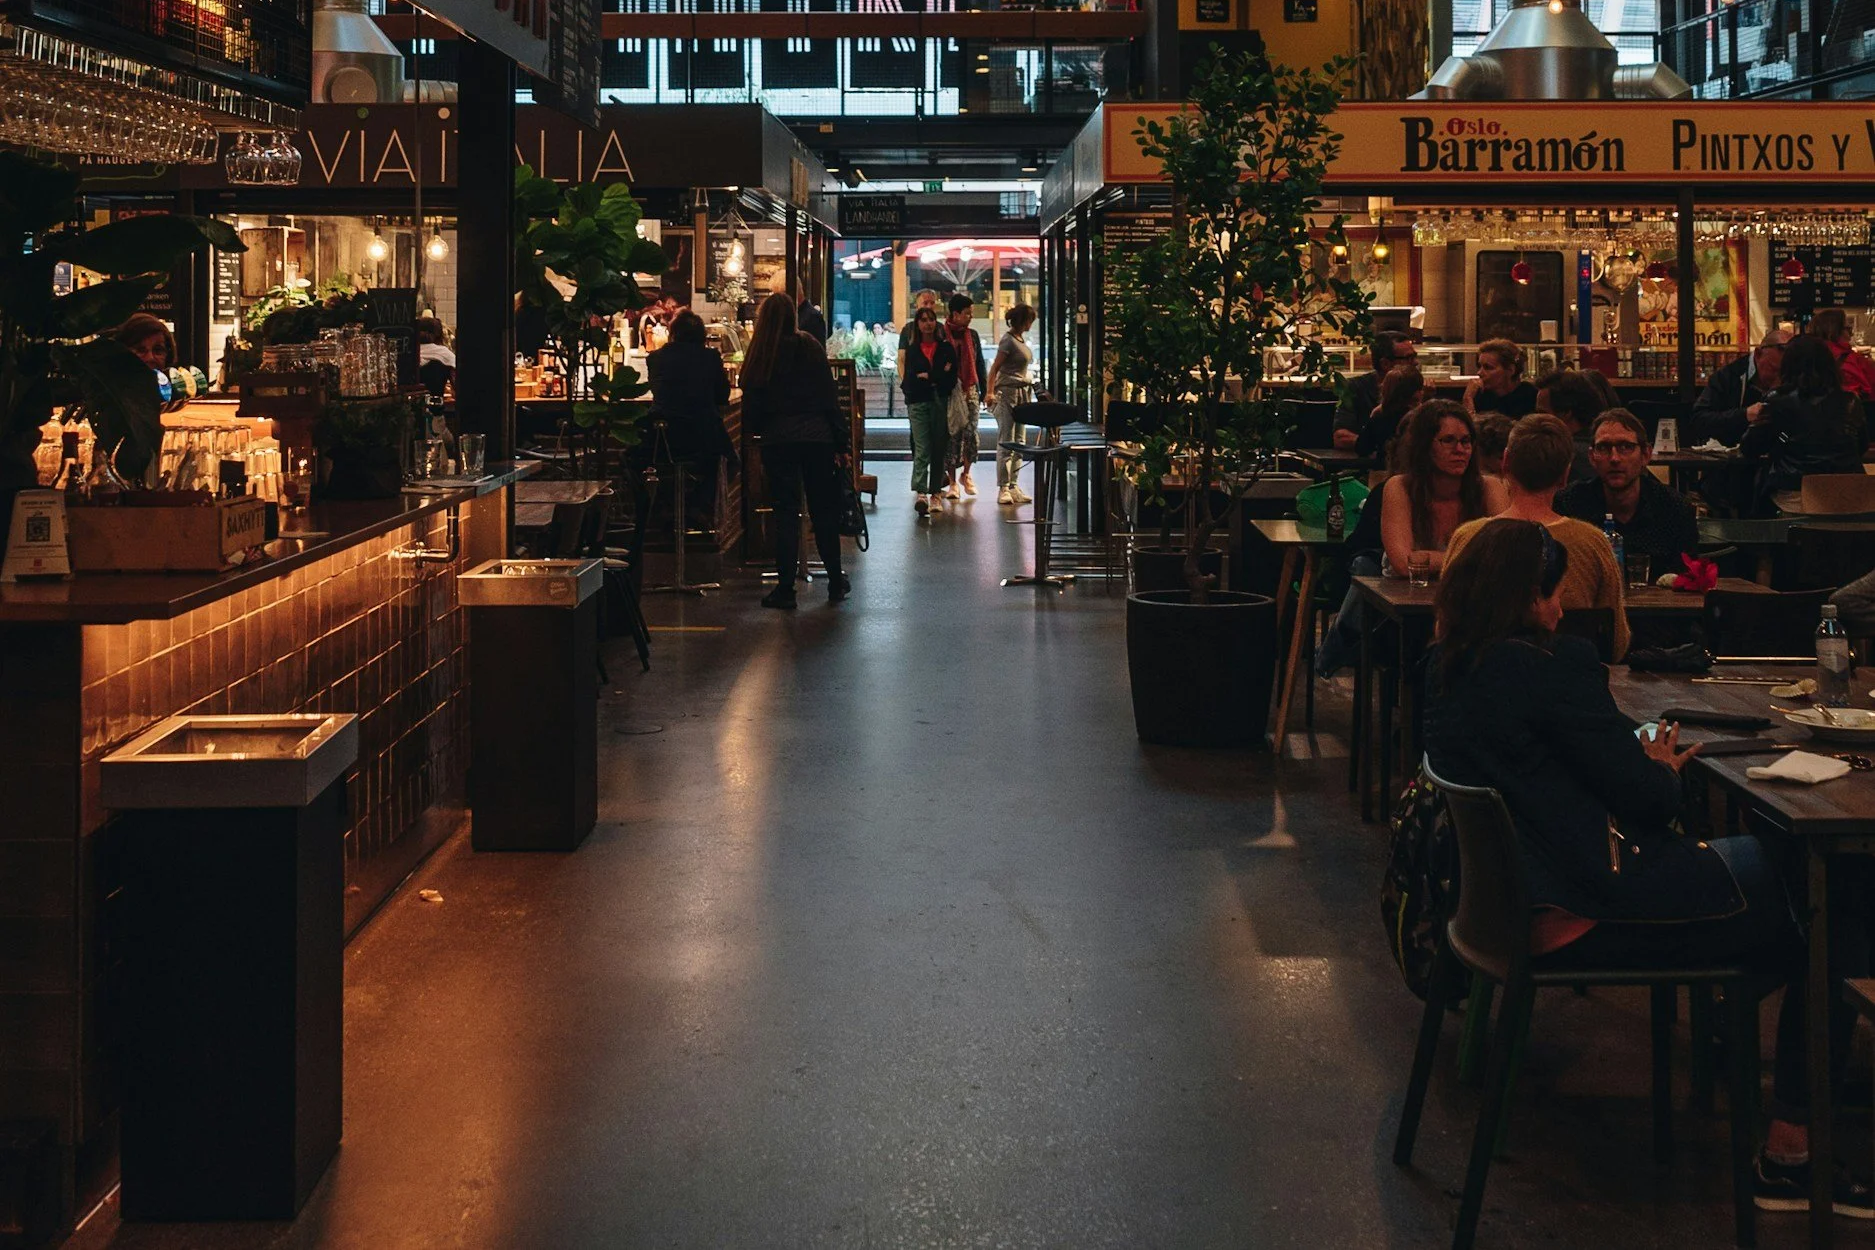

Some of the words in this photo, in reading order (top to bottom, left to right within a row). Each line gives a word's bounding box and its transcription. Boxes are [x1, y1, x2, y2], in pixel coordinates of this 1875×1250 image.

[307, 129, 417, 184] VIA
[1400, 117, 1626, 172] Barramón
[1672, 119, 1814, 171] PINTXOS
